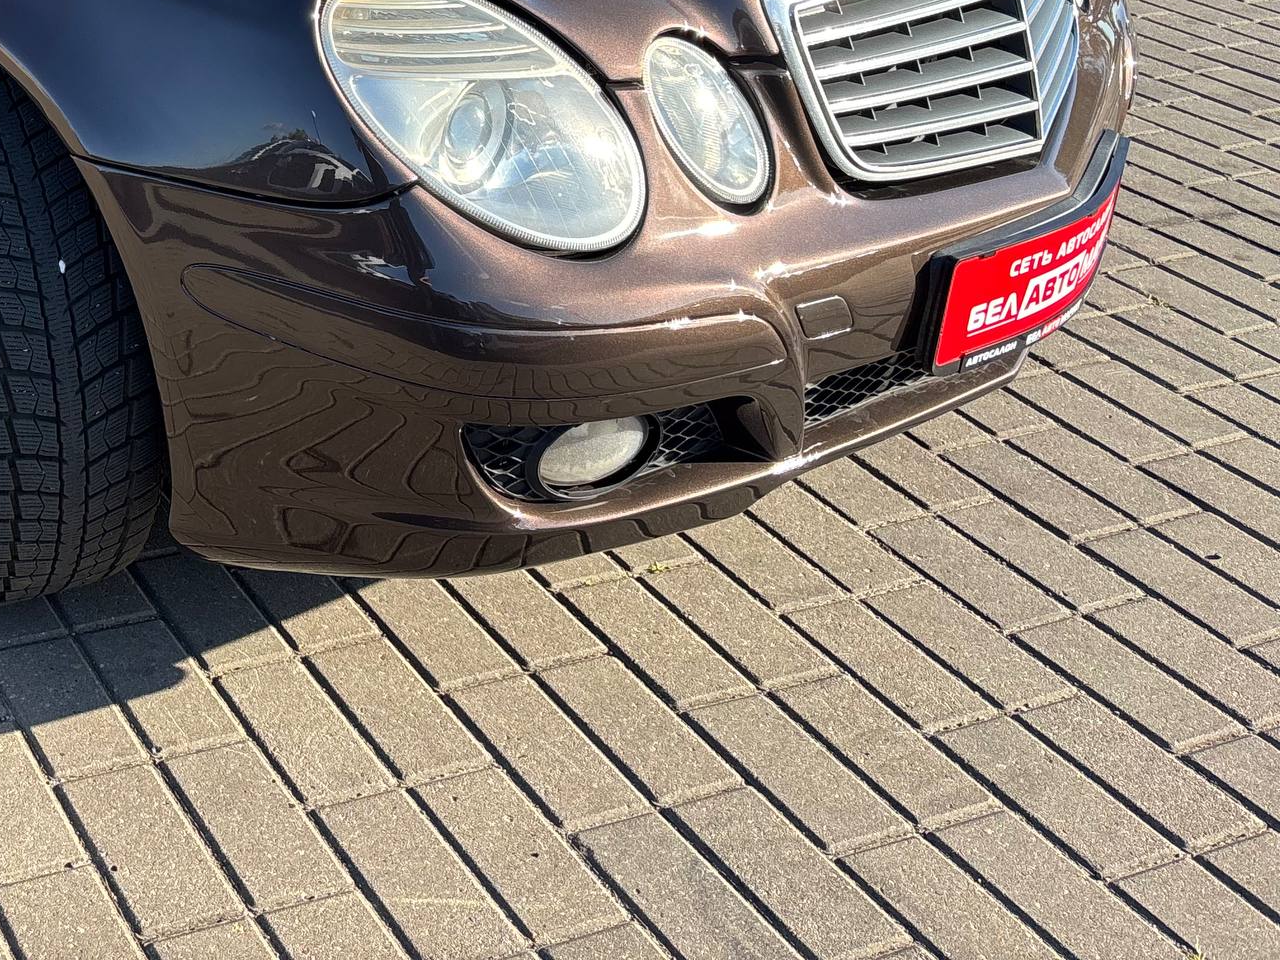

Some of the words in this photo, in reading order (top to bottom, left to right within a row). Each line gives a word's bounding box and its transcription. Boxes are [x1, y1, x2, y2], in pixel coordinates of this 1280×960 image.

[1009, 249, 1053, 277] СЕТЬ
[966, 292, 1018, 332] БЕЛ
[965, 340, 1018, 367] АВТОСАЛОН
